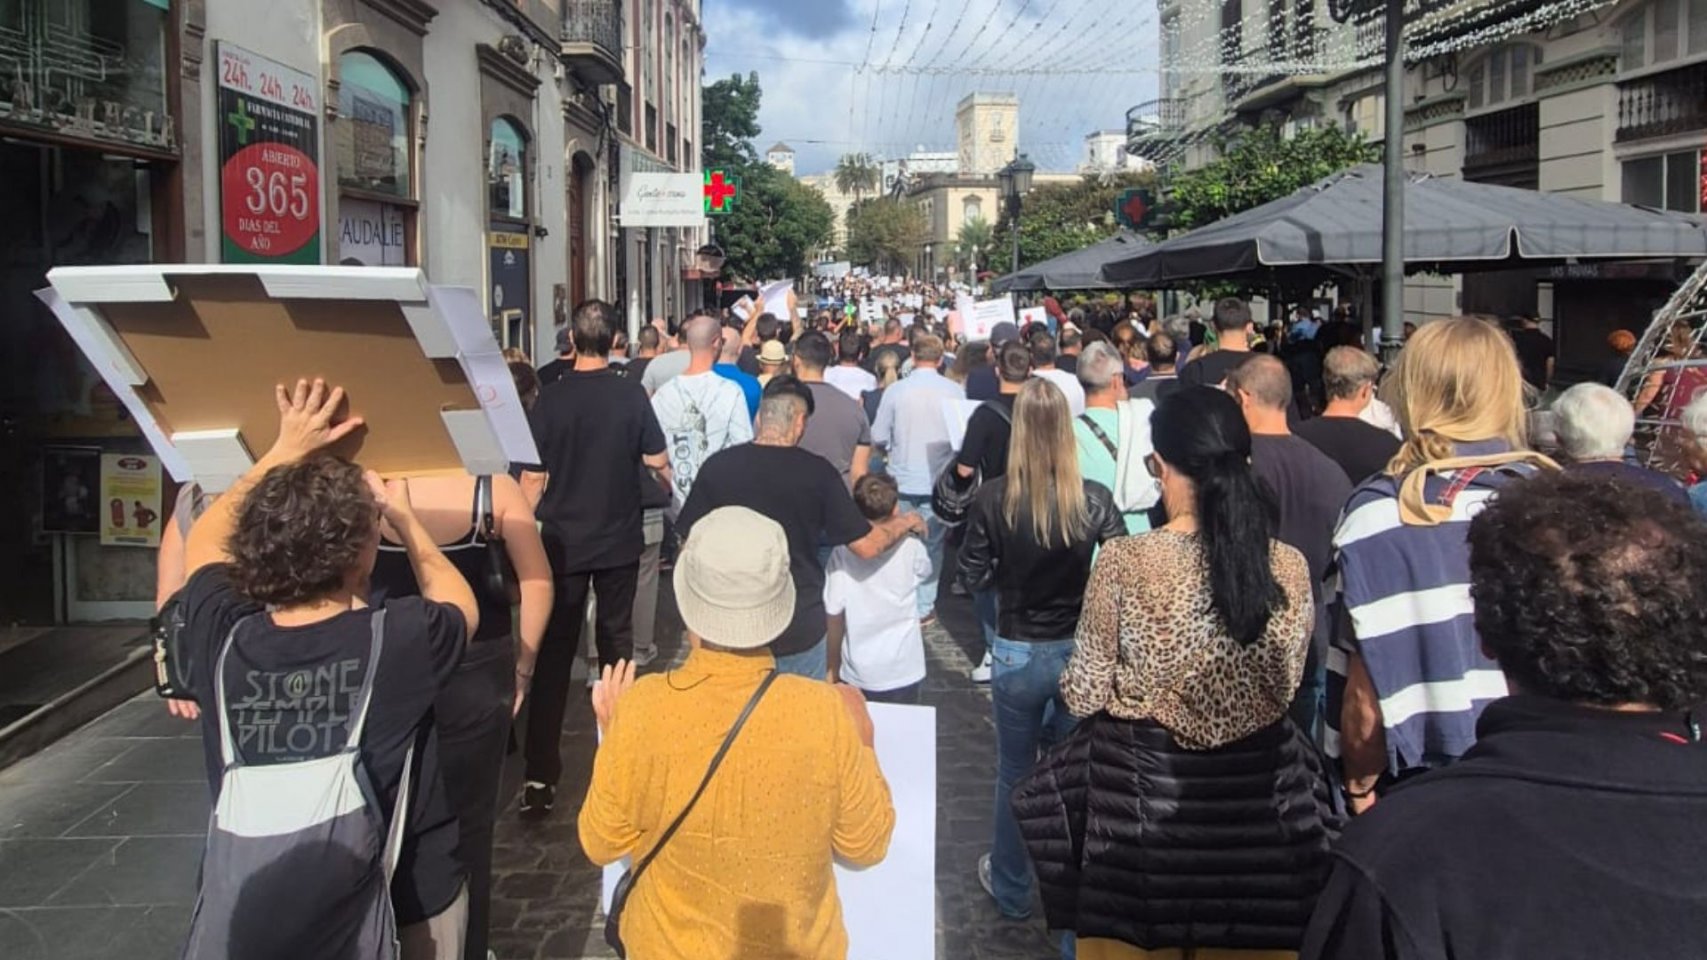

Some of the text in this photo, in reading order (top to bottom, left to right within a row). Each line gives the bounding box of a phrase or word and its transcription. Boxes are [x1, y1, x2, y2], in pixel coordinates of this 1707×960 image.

[261, 149, 301, 168] ABIERTO
[245, 166, 309, 220] 365
[250, 233, 271, 250] AÑO
[263, 220, 281, 234] DEL
[338, 215, 403, 248] AUDALÍE
[242, 658, 361, 703] STONE
[238, 722, 348, 754] PILOT
